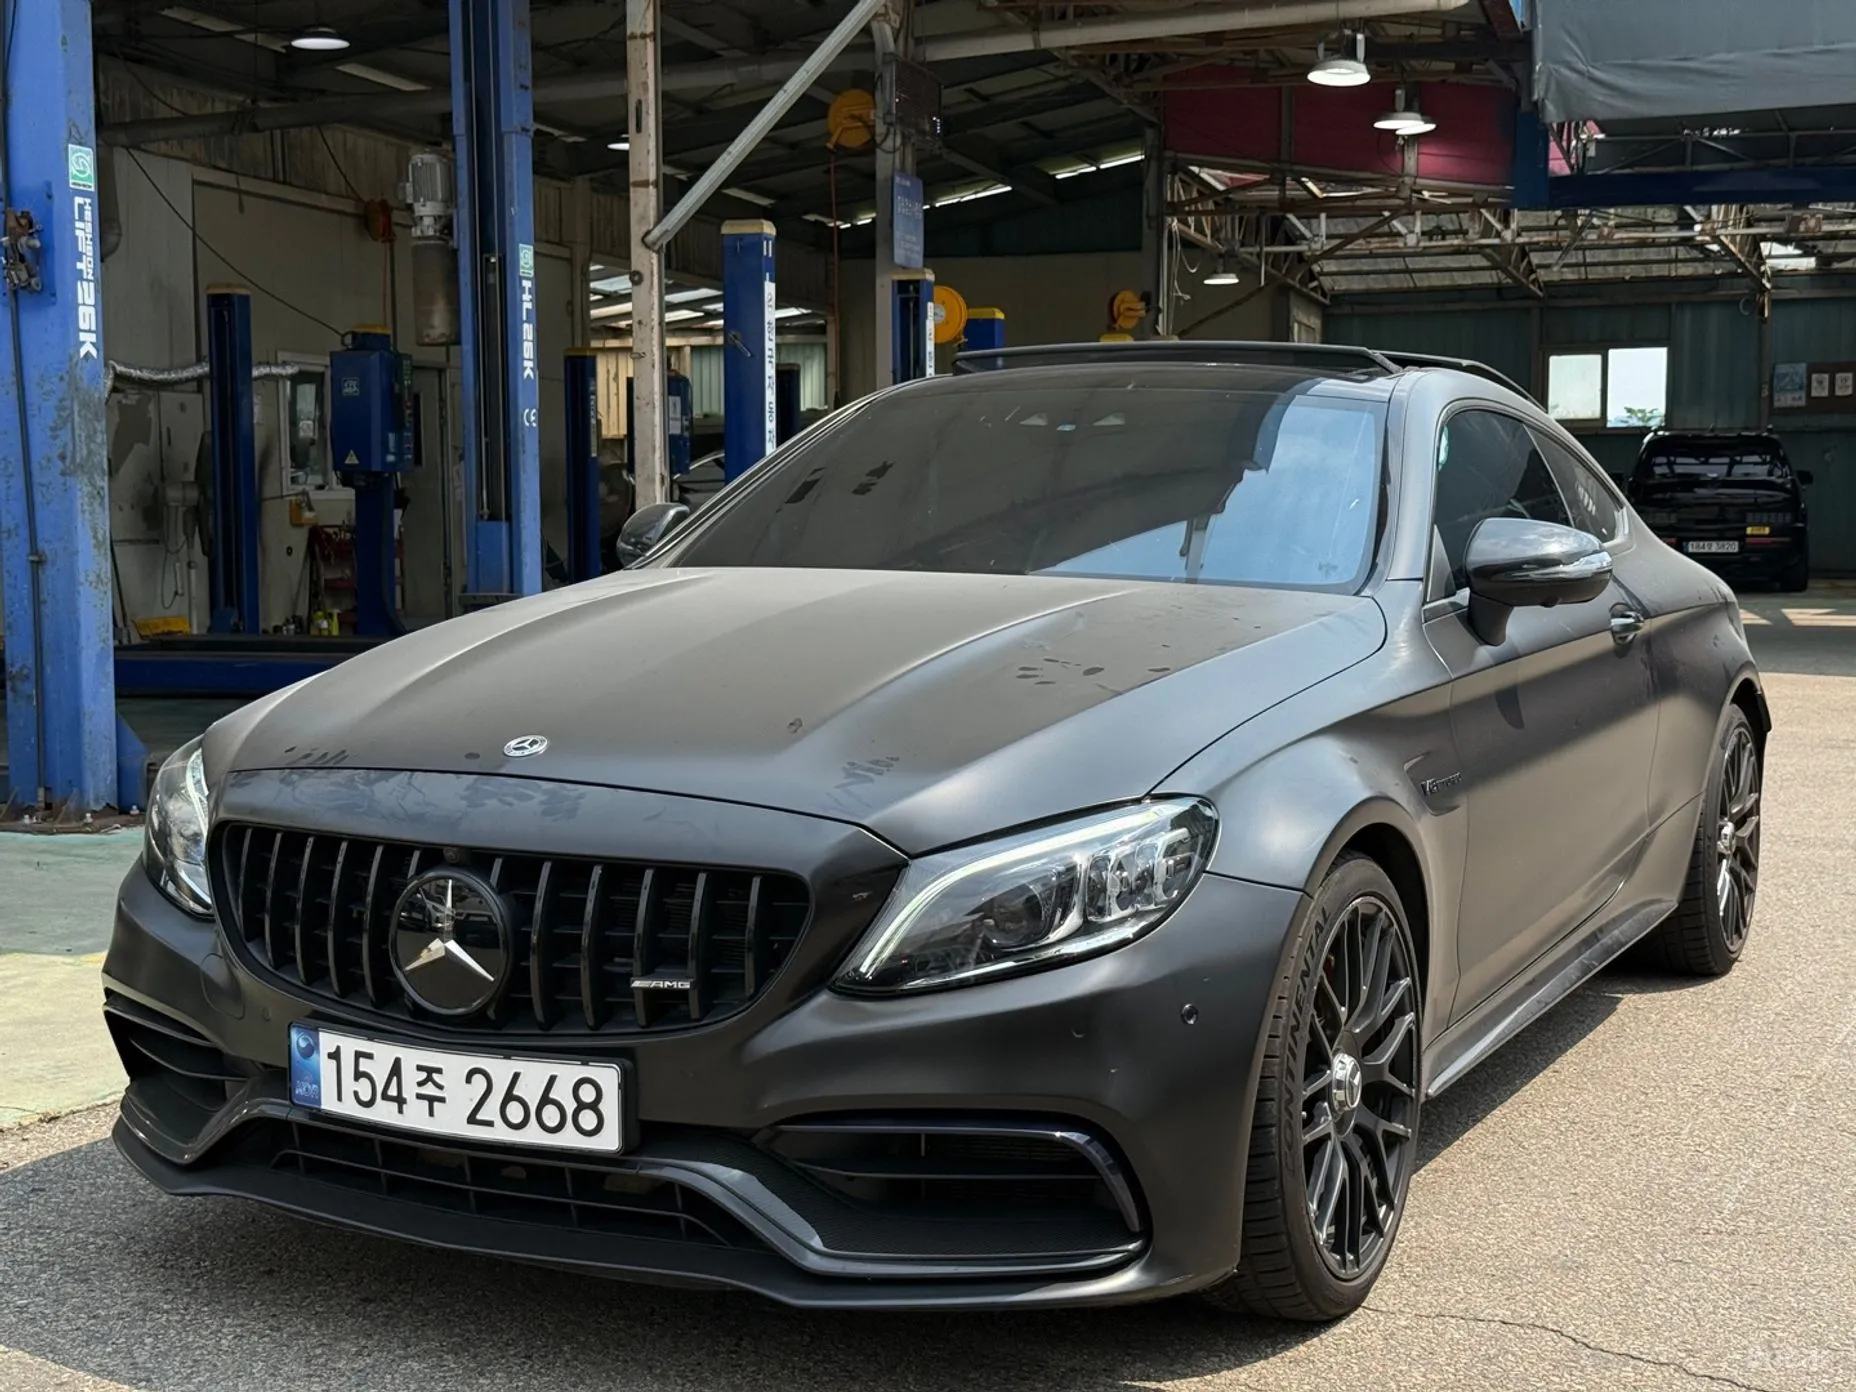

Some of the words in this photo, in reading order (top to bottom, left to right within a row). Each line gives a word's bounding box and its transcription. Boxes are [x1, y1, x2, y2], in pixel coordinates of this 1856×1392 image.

[74, 195, 88, 280] LIFT
[649, 980, 691, 989] AMG
[326, 1044, 447, 1118] 154주
[464, 1066, 605, 1138] 2668
